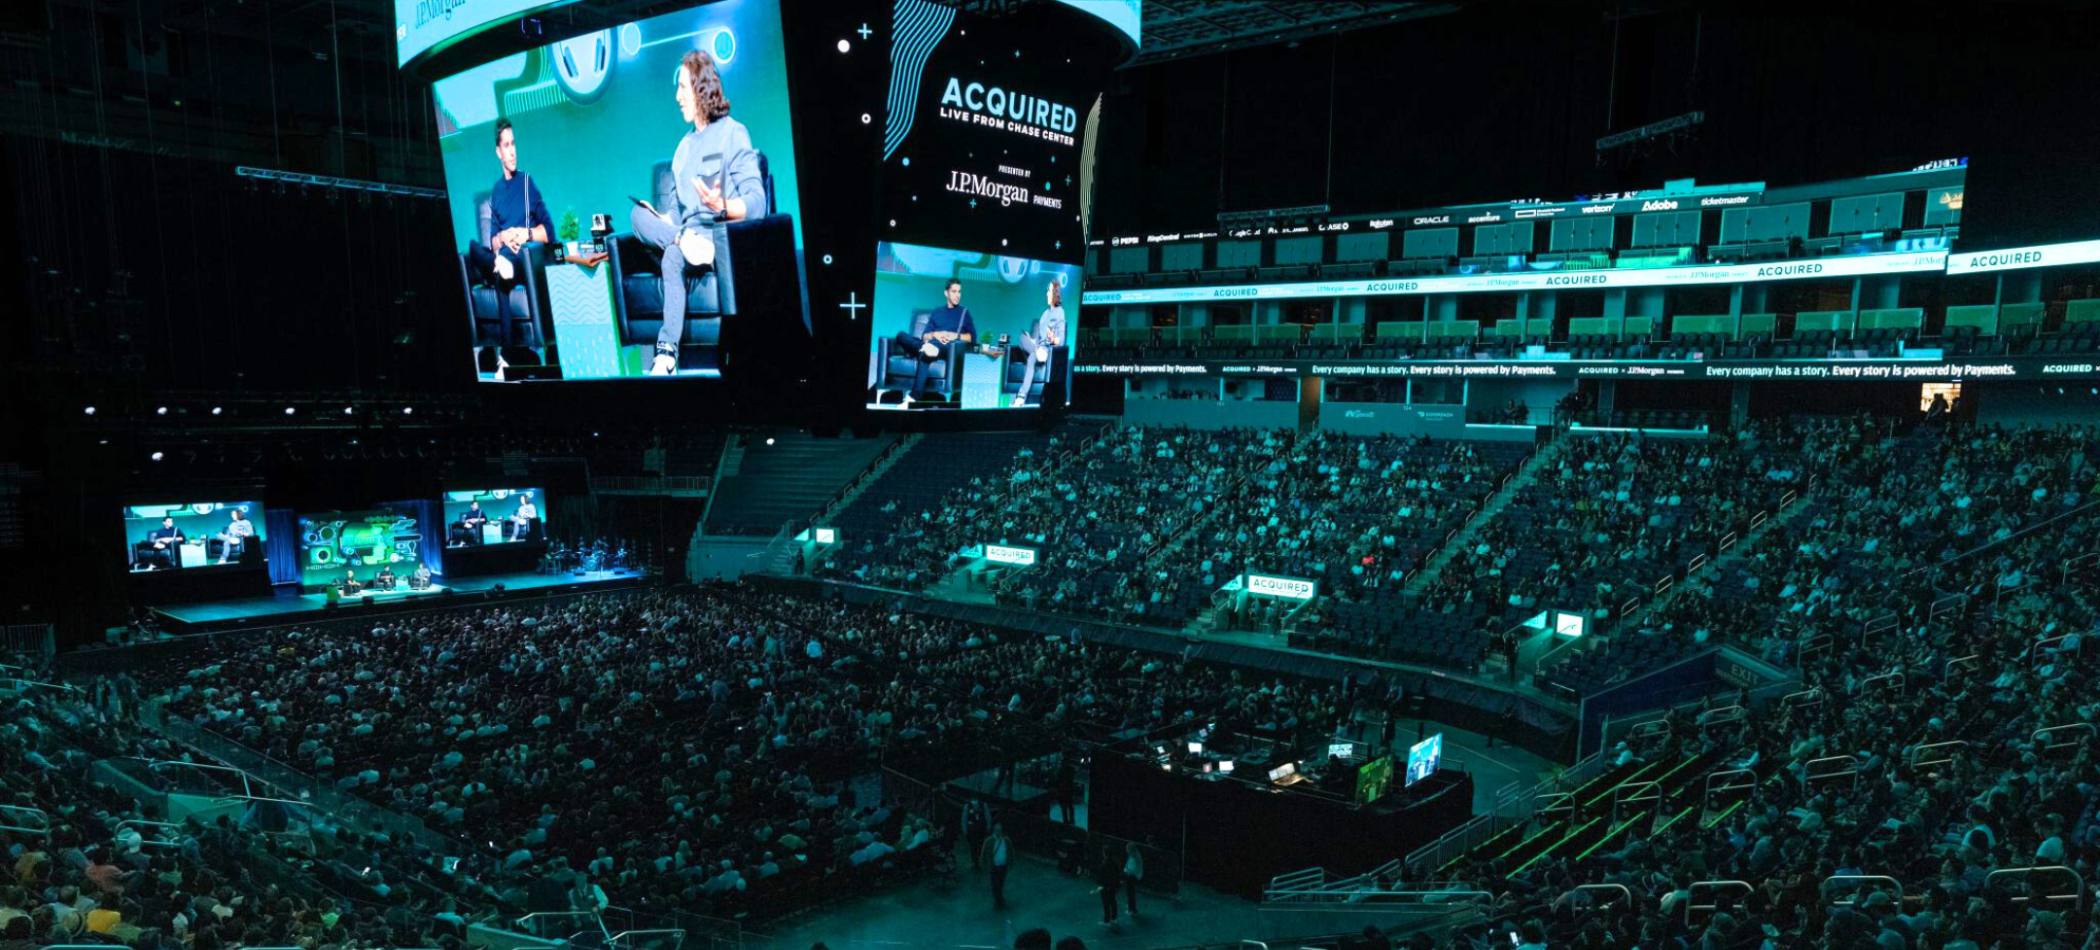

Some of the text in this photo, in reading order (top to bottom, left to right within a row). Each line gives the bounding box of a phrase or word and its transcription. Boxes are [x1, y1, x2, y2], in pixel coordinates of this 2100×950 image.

[941, 77, 1077, 133] ACQUIRED
[940, 107, 1075, 146] LIVE FROM CHASE CENTER
[998, 164, 1024, 177] PRESENTED
[946, 170, 1029, 206] J.P.Morgan
[1033, 195, 1062, 209] PAYMENTS
[1641, 199, 1679, 212] Adobe
[1701, 196, 1749, 206] ticketmaster
[1413, 215, 1450, 225] ORACLE
[1468, 215, 1500, 223] accenture
[1120, 236, 1139, 245] PEPSI
[1970, 251, 2042, 268] ACQUIRED
[1757, 263, 1823, 277] ACQUIRED
[1545, 274, 1607, 286] ACQUIRED
[1213, 287, 1258, 298] ACQUIRED
[1366, 281, 1419, 292] ACQUIRED
[1083, 292, 1121, 302] ACQUIRED
[1086, 364, 1102, 374] story.
[1102, 364, 1118, 374] Every
[1119, 364, 1133, 374] story
[1140, 364, 1166, 374] powered
[1175, 364, 1207, 374] Payments.
[1312, 365, 1332, 375] Every
[1333, 366, 1366, 375] company
[1366, 365, 1380, 374] has
[1387, 366, 1409, 376] story.
[1410, 365, 1432, 376] Every
[1433, 365, 1453, 376] story
[1455, 365, 1462, 374] is
[1463, 365, 1499, 376] powered
[1500, 365, 1511, 376] by
[1512, 365, 1557, 376] Payments.
[1626, 366, 1665, 376] J.P.Morgan
[1706, 366, 1731, 377] Every
[1732, 367, 1774, 377] company
[1775, 365, 1793, 376] has
[1802, 365, 1831, 377] story.
[1832, 365, 1861, 378] Every
[1862, 365, 1892, 378] story
[1892, 364, 1902, 376] is
[1903, 364, 1949, 378] powered
[1950, 364, 1963, 377] by
[1964, 364, 2017, 377] Payments.
[2042, 364, 2093, 373] ACQUIRED
[990, 547, 1032, 560] ACQUIRED
[1254, 579, 1309, 592] ACQUIRED
[1731, 664, 1759, 685] EXIT
